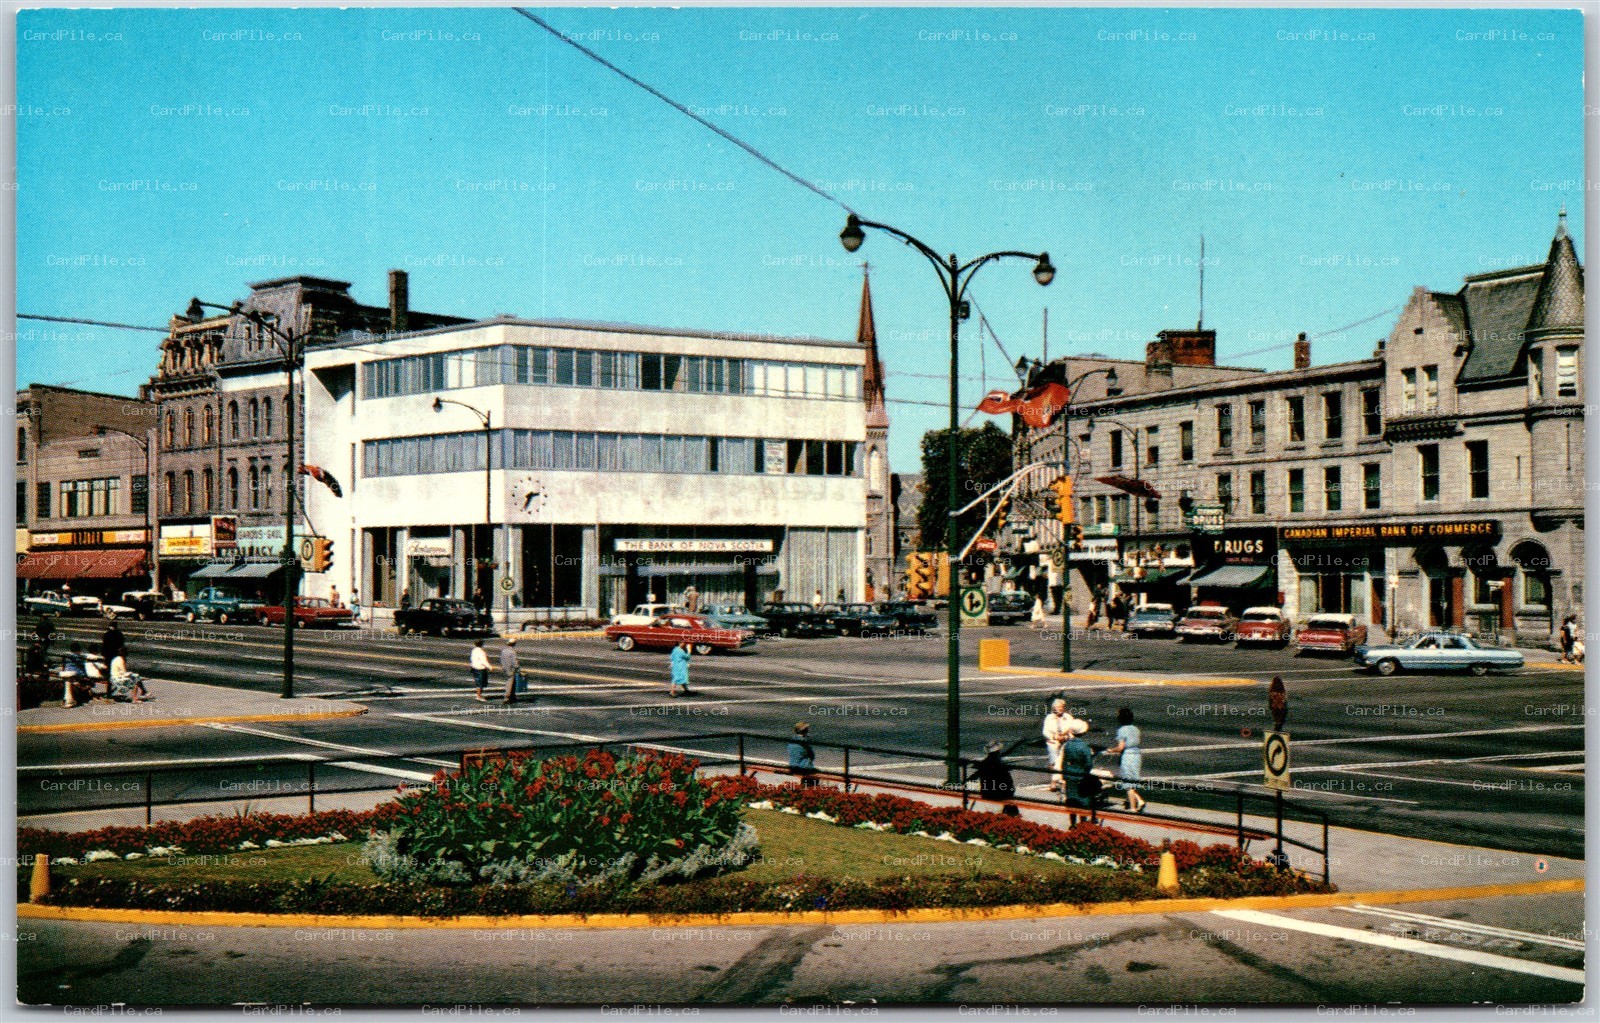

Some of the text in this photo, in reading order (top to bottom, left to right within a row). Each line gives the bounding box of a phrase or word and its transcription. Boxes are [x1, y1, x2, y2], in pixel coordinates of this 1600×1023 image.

[1193, 515, 1224, 525] DRUGS
[1284, 523, 1493, 539] CANADIAN IMPERIAL BANK OF COMMERCE
[624, 541, 765, 550] THE BANK OF NOVA SCOTIA
[1213, 539, 1264, 554] DRUGS
